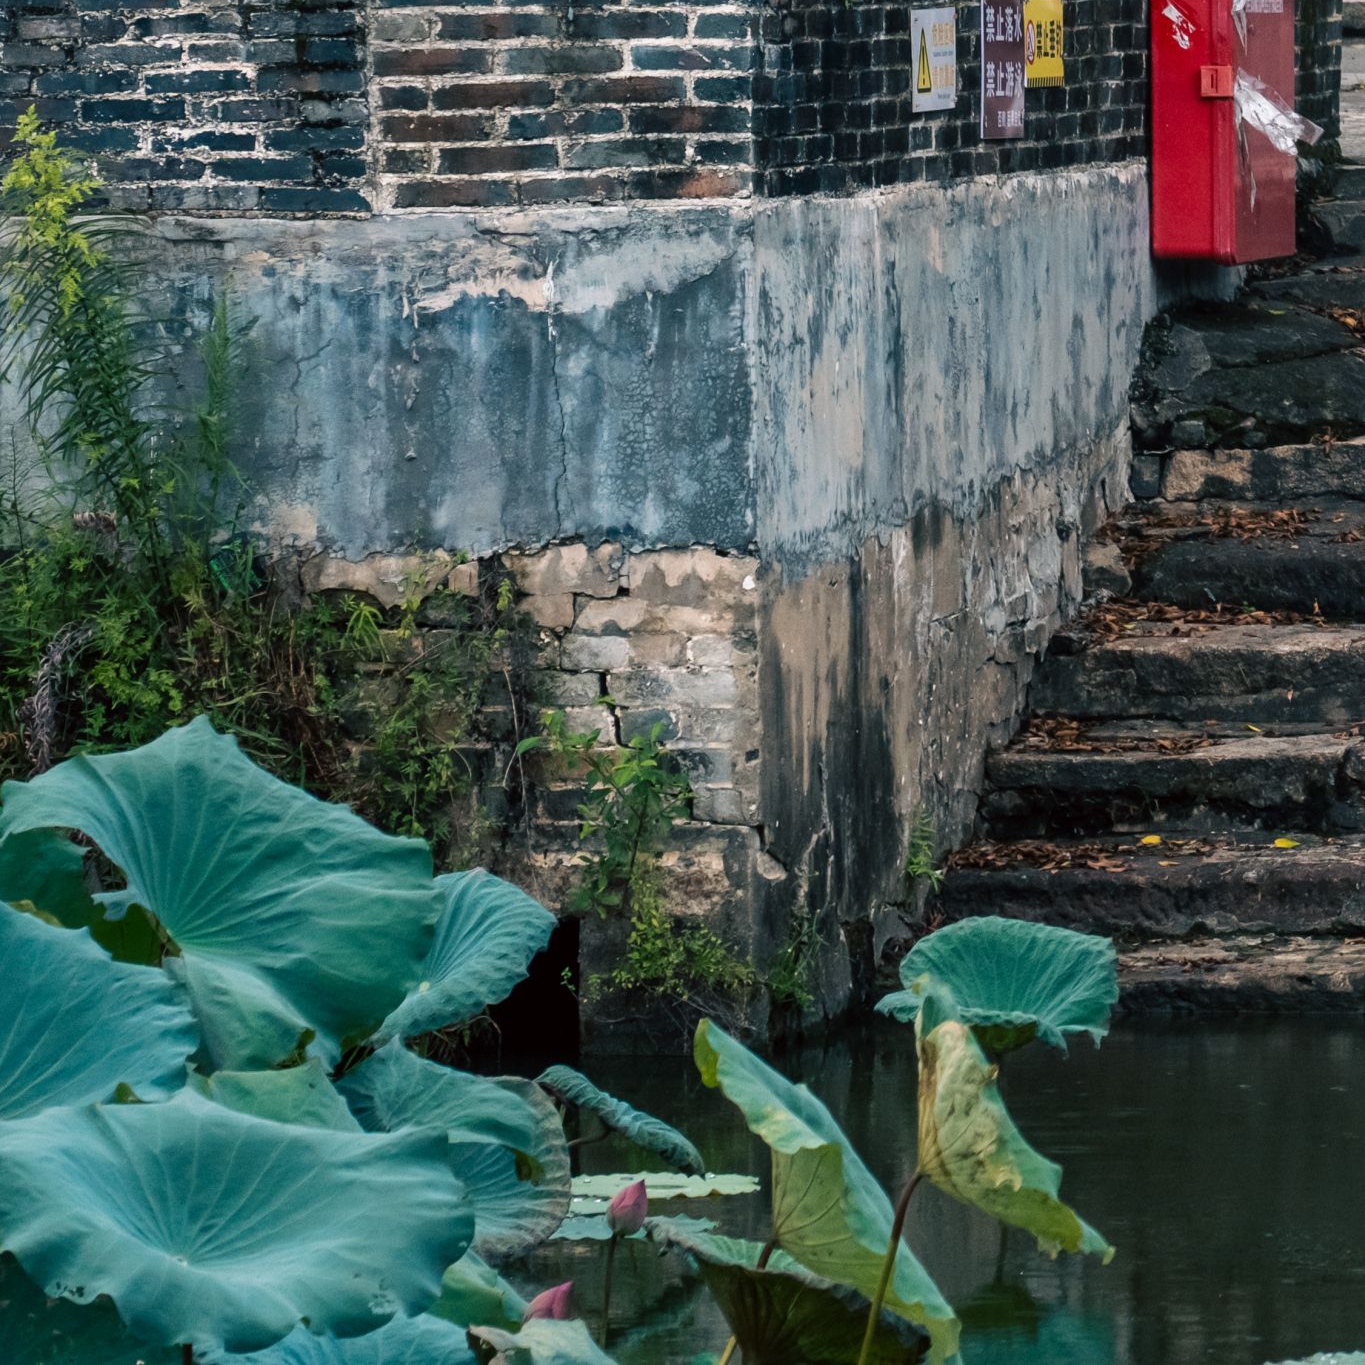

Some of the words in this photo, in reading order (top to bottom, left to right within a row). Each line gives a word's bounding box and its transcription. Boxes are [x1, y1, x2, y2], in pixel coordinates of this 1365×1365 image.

[985, 6, 1023, 43] 禁止落水
[986, 61, 1023, 97] 禁止游泳
